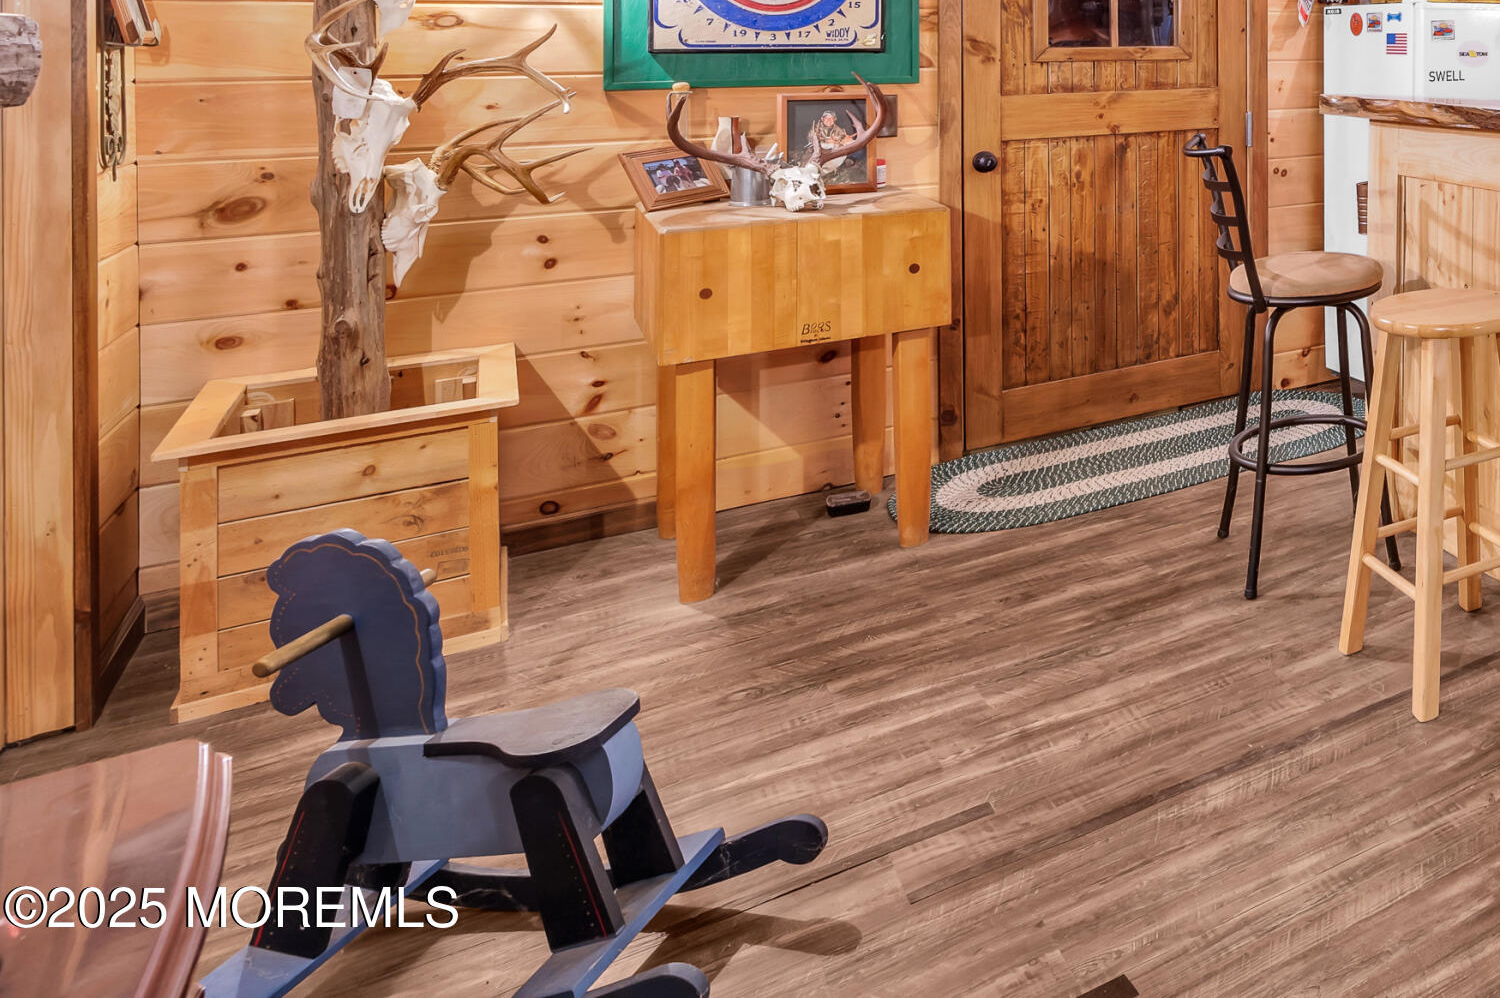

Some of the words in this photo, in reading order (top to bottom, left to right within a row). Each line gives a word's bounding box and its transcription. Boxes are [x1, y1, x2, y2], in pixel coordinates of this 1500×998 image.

[848, 1, 861, 9] 15
[706, 18, 714, 26] 7
[827, 18, 835, 26] 2
[733, 29, 747, 37] 19
[769, 32, 777, 41] 3
[797, 30, 811, 38] 17
[1428, 69, 1465, 82] SWELL
